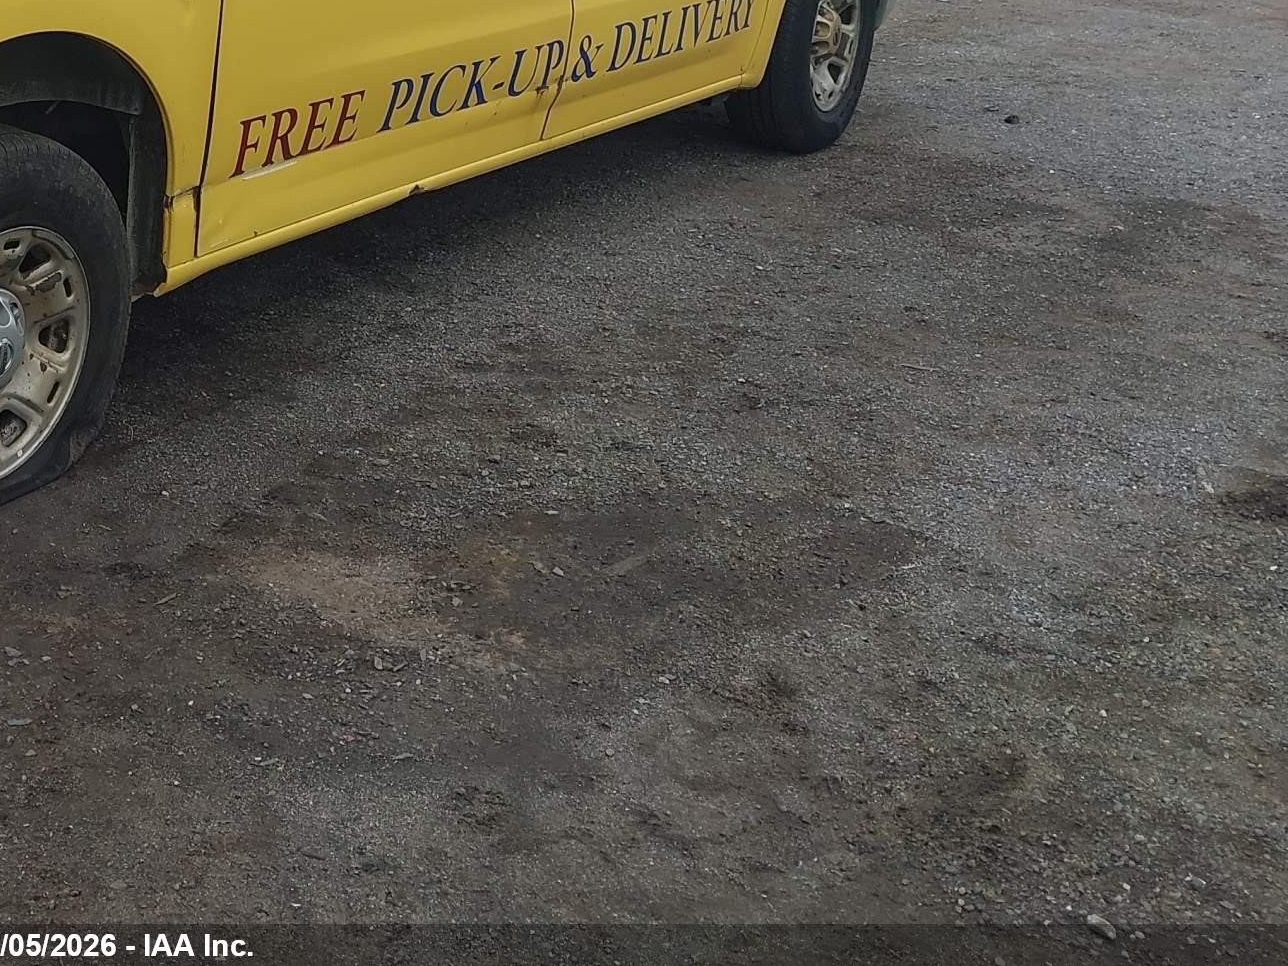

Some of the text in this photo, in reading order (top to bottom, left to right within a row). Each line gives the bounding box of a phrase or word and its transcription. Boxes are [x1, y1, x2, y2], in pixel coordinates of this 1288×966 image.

[229, 90, 367, 179] FREE
[378, 39, 566, 133] PICK-UP
[571, 34, 604, 83] &
